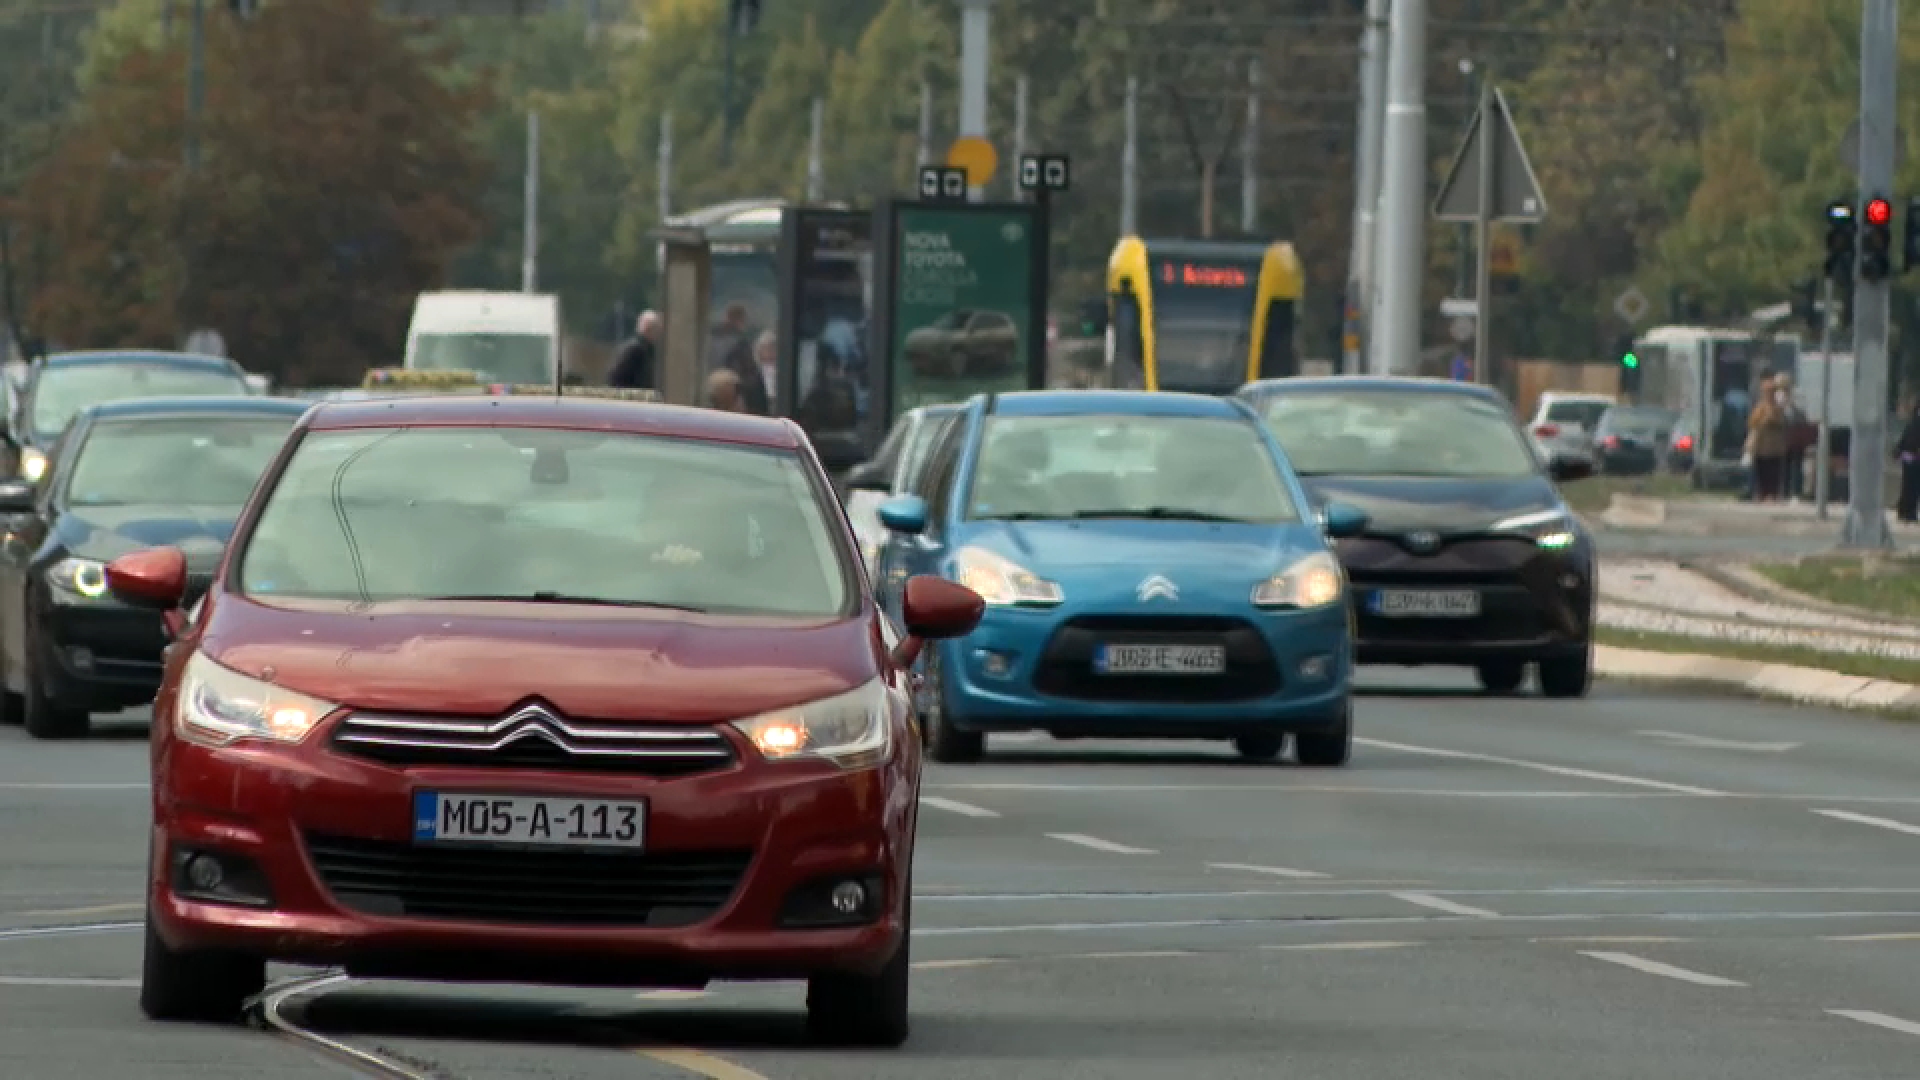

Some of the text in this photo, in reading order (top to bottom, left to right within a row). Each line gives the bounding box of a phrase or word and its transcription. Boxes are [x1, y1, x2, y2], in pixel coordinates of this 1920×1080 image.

[905, 231, 950, 248] NOVA
[905, 251, 965, 267] TOYOTA
[443, 798, 637, 841] M05-A-113
